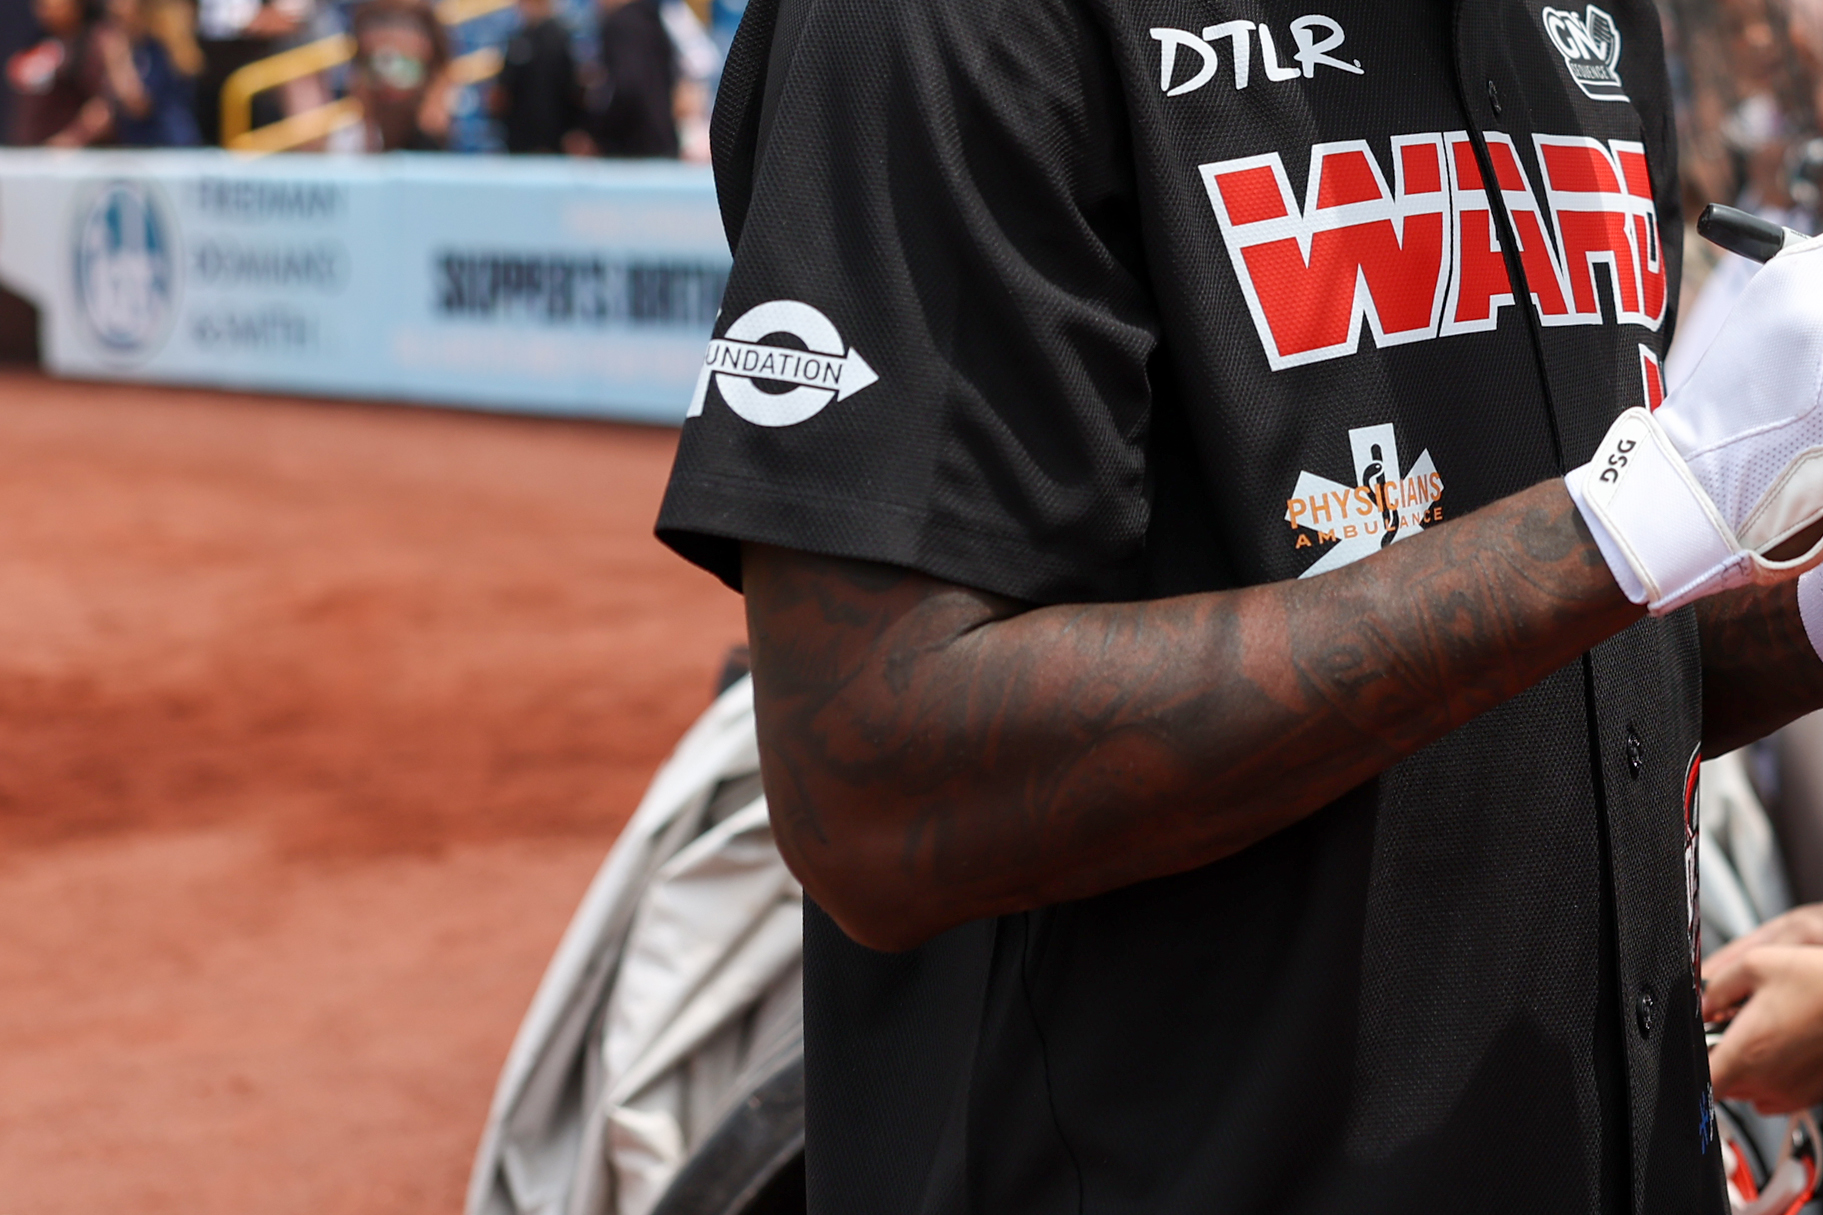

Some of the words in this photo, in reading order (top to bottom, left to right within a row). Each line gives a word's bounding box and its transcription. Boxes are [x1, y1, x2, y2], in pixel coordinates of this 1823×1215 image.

[1199, 131, 1667, 371] WARD
[1600, 439, 1636, 483] DSG
[1287, 472, 1441, 529] PHYSICIANS
[1295, 507, 1443, 550] AMBULANCE
